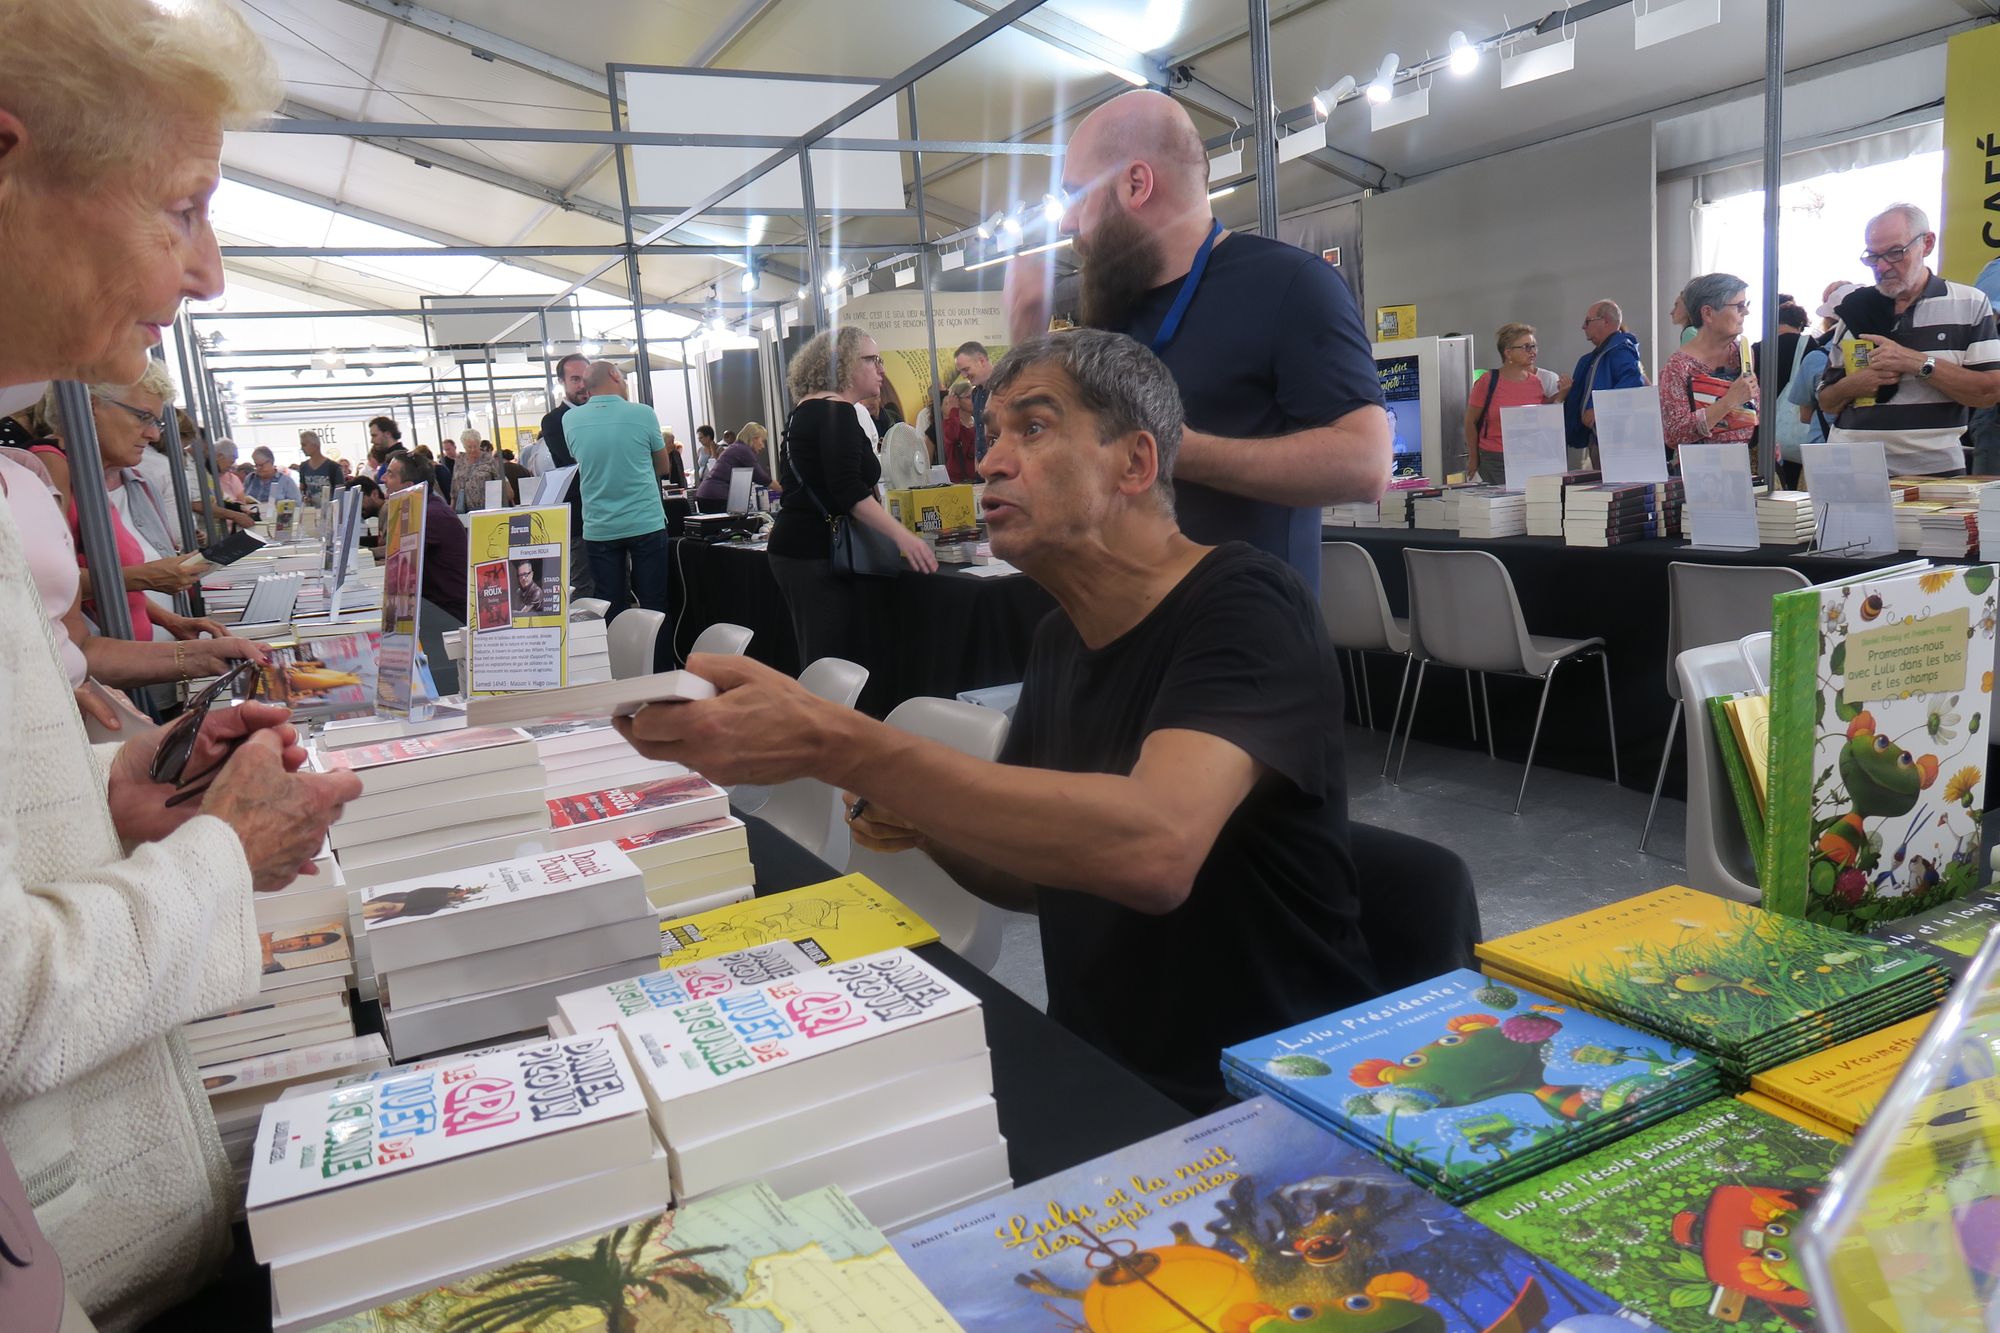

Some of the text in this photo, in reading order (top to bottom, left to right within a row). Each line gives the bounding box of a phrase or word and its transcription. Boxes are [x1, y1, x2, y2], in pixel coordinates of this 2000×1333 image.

[484, 587, 502, 597] ROUX
[1848, 651, 1961, 680] avec Lulu dans les bois
[1868, 641, 1944, 660] Promenons-nous
[1871, 671, 1938, 691] et les champs
[537, 854, 572, 885] Picouly
[567, 849, 611, 878] Daniel
[1887, 934, 1916, 946] ulu
[1919, 924, 1938, 934] et
[1932, 918, 1957, 927] le
[1948, 903, 1998, 919] loup
[767, 980, 867, 1038] LE CRI
[828, 961, 923, 1022] PICOULY
[868, 955, 950, 1008] DANIEL
[716, 989, 794, 1064] MUET DE
[1276, 1028, 1344, 1050] Lulu,
[1342, 987, 1455, 1029] Présidente
[1316, 1041, 1351, 1056] Daniel
[1352, 1028, 1390, 1044] Picouly
[1397, 1011, 1438, 1028] Frédéric
[1439, 1000, 1465, 1013] Pillot
[442, 1063, 520, 1138] LE CRI
[517, 1042, 582, 1123] PICOULY
[562, 1037, 625, 1108] DANIEL
[1794, 1069, 1836, 1086] Lulu
[378, 1071, 437, 1140] MUET
[1184, 1111, 1260, 1144] FRÉDÉRIC PILLOT
[378, 1136, 414, 1166] DE
[1496, 1111, 1740, 1221] Lulu fait l'école buissonnière
[1558, 1194, 1599, 1217] Daniel
[1599, 1177, 1642, 1198] Picouly
[1649, 1150, 1698, 1174] Frédéric
[1699, 1137, 1728, 1153] Pillot
[995, 1145, 1236, 1249] Lulu et la nuit
[1032, 1170, 1241, 1260] des sept contes
[911, 1212, 997, 1249] DANIEL PICOULY
